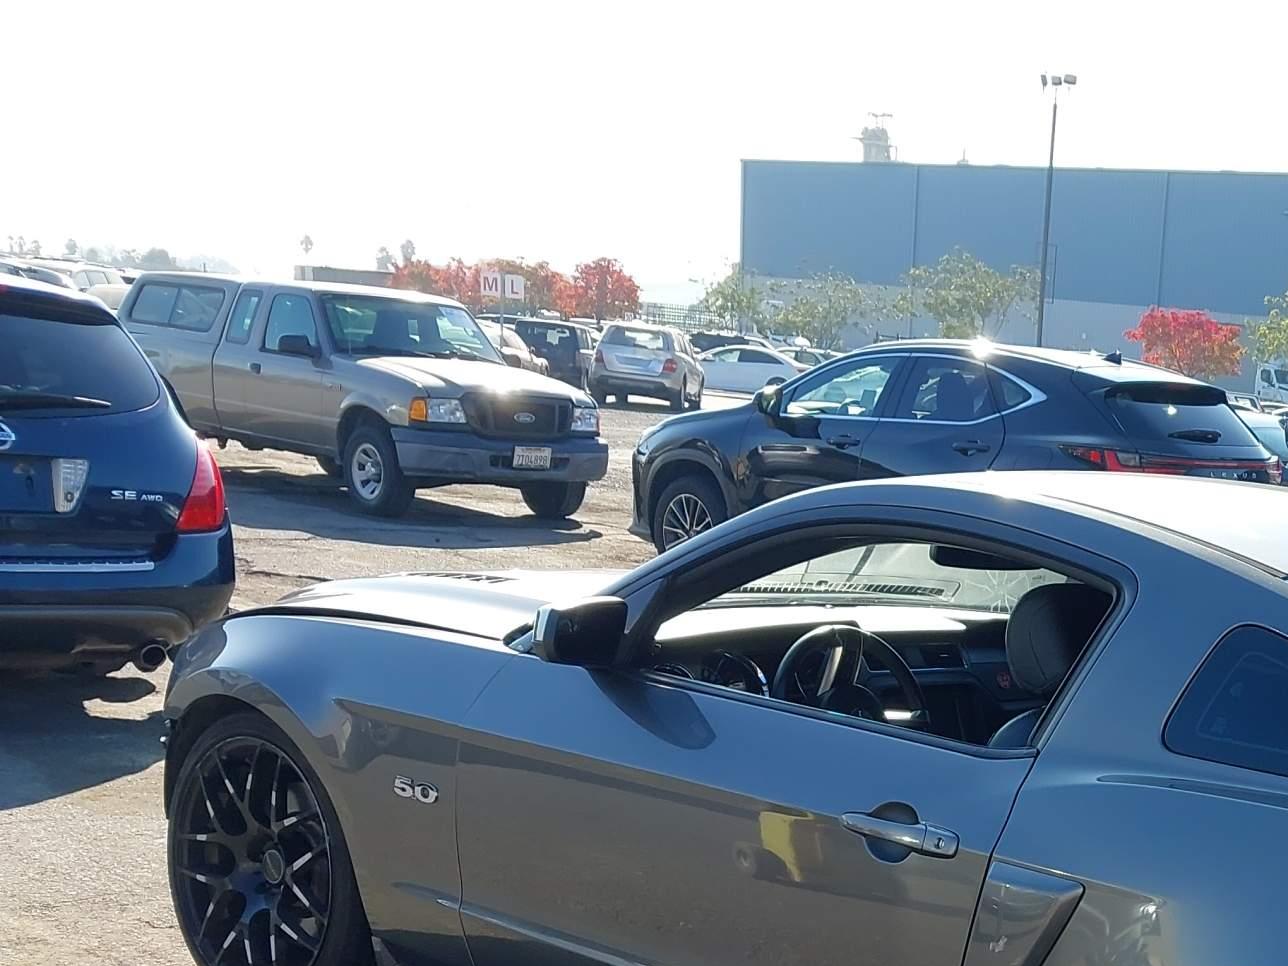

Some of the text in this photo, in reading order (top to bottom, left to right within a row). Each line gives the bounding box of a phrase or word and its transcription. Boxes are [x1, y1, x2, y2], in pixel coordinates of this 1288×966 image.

[483, 276, 498, 292] M
[511, 279, 519, 295] L
[1210, 471, 1257, 479] LEXUS
[111, 490, 163, 502] SE AWD
